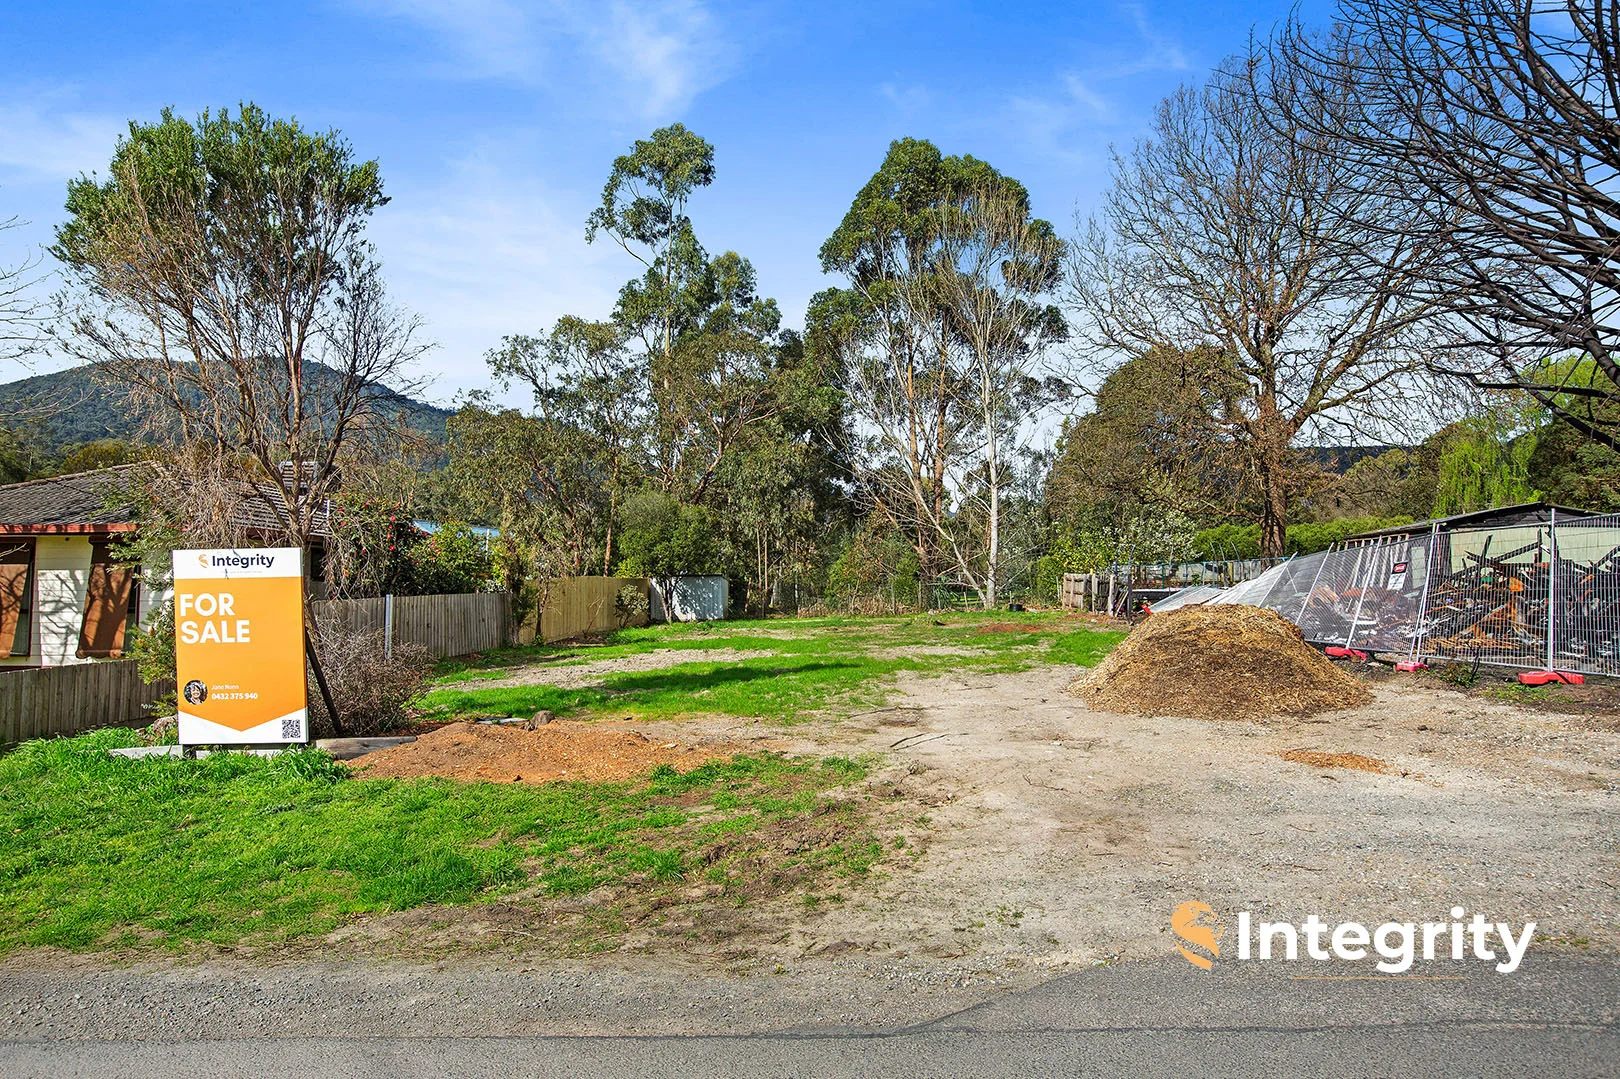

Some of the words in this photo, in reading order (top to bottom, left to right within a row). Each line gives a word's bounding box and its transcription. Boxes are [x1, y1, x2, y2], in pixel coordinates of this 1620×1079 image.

[212, 553, 275, 569] Integrity
[179, 592, 235, 616] FOR
[180, 619, 250, 644] SALE
[230, 692, 244, 700] 375
[244, 692, 258, 700] 940
